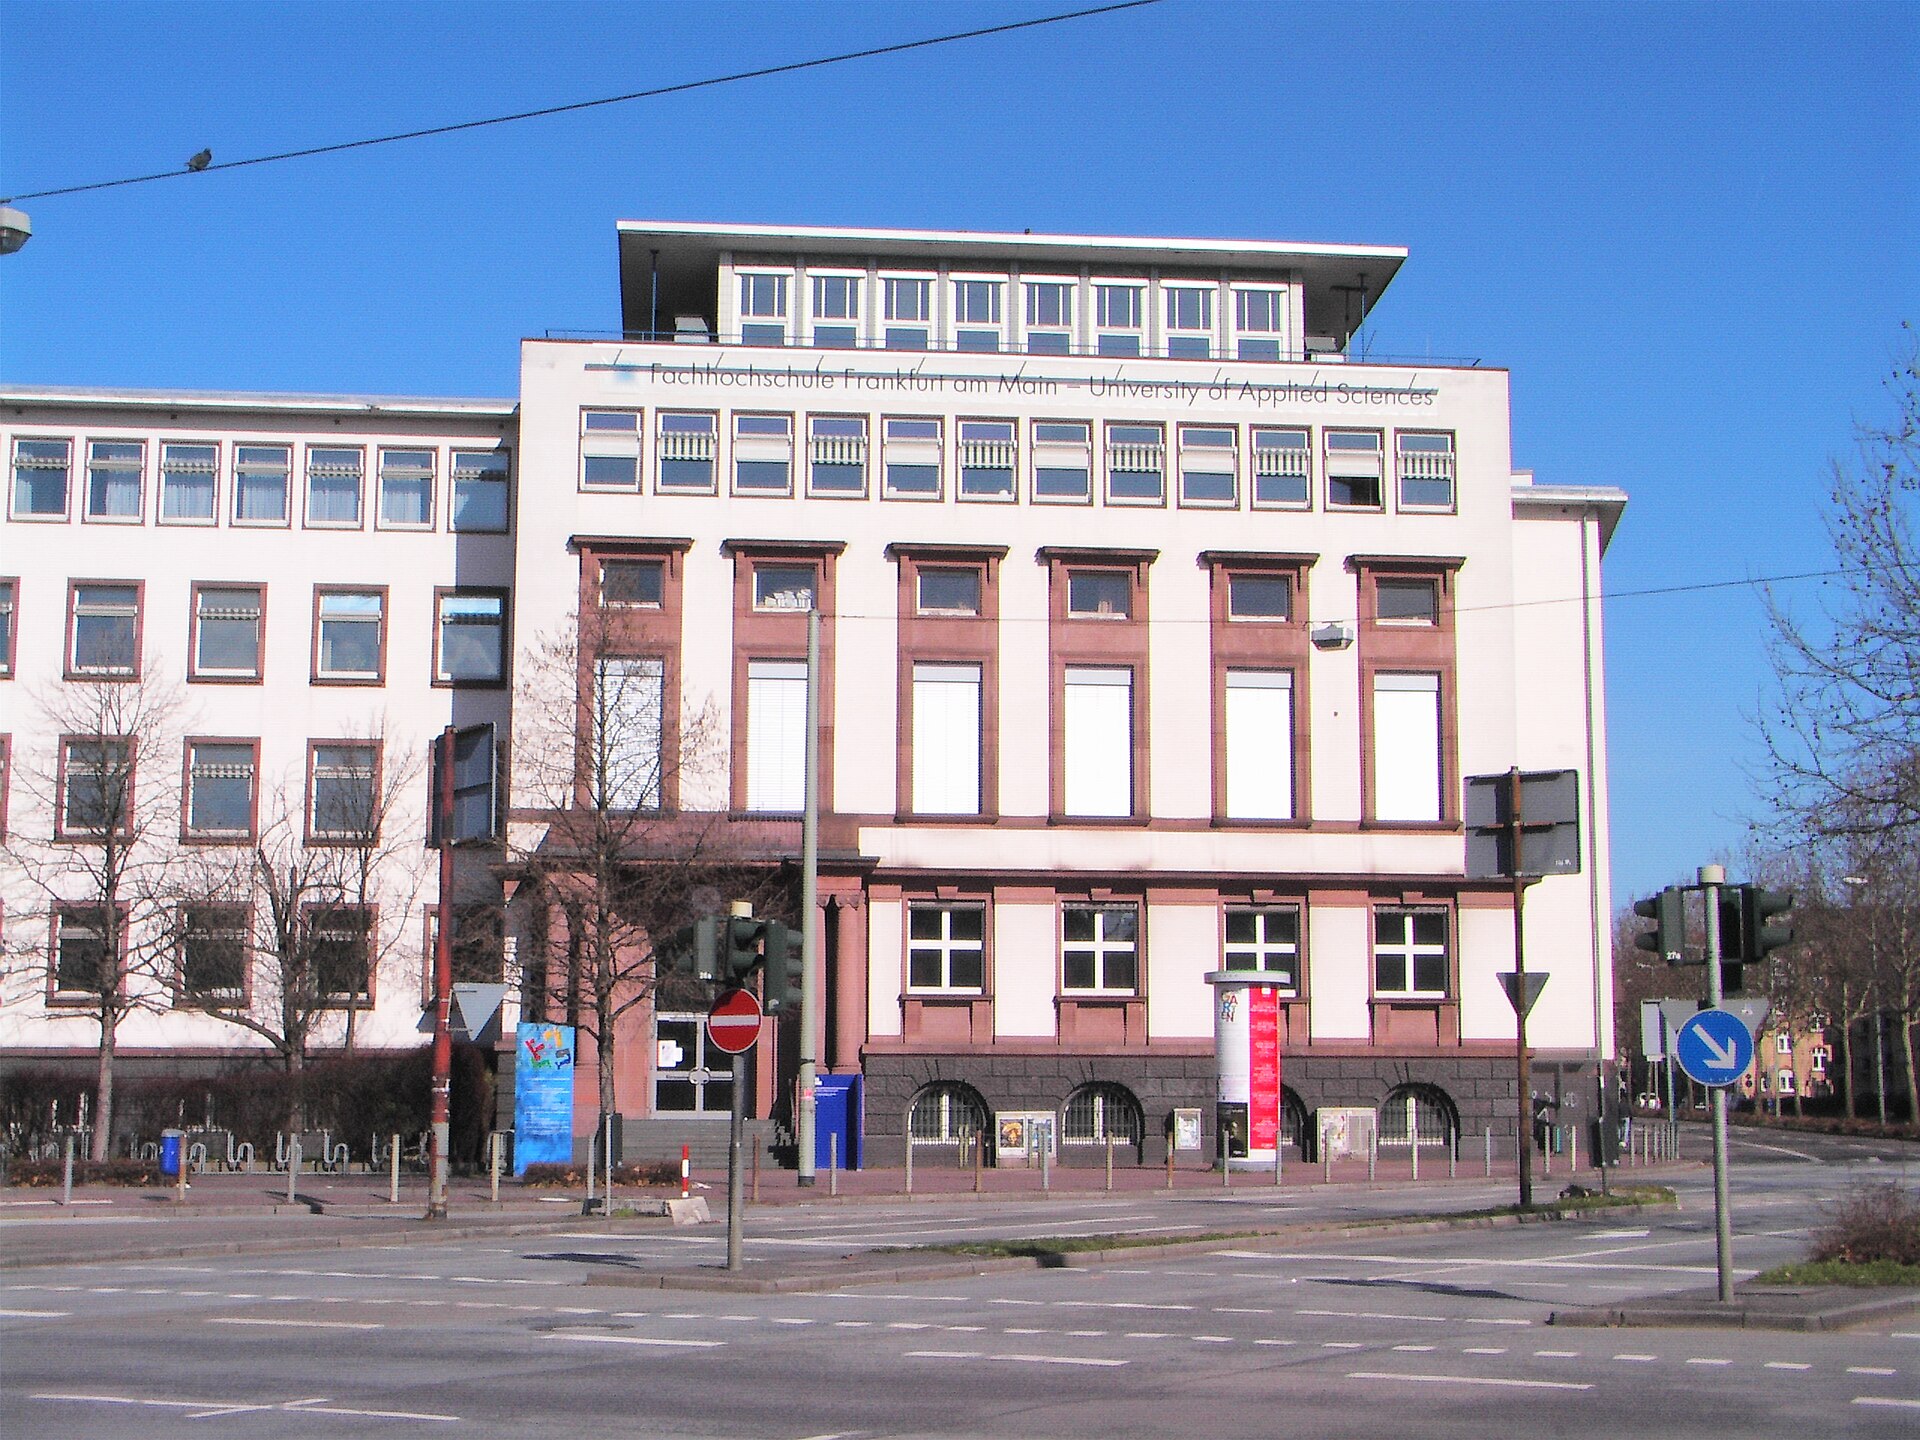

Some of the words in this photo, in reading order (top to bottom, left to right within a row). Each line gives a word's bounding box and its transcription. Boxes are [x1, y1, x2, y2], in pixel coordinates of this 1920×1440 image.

[650, 362, 835, 390] Fachhochschule
[844, 367, 943, 393] Frankfurt
[953, 377, 988, 393] am
[998, 373, 1057, 396] Main
[1089, 374, 1200, 407] University
[1208, 377, 1231, 401] of
[1238, 378, 1327, 408] Applied
[1337, 382, 1434, 406] Sciences
